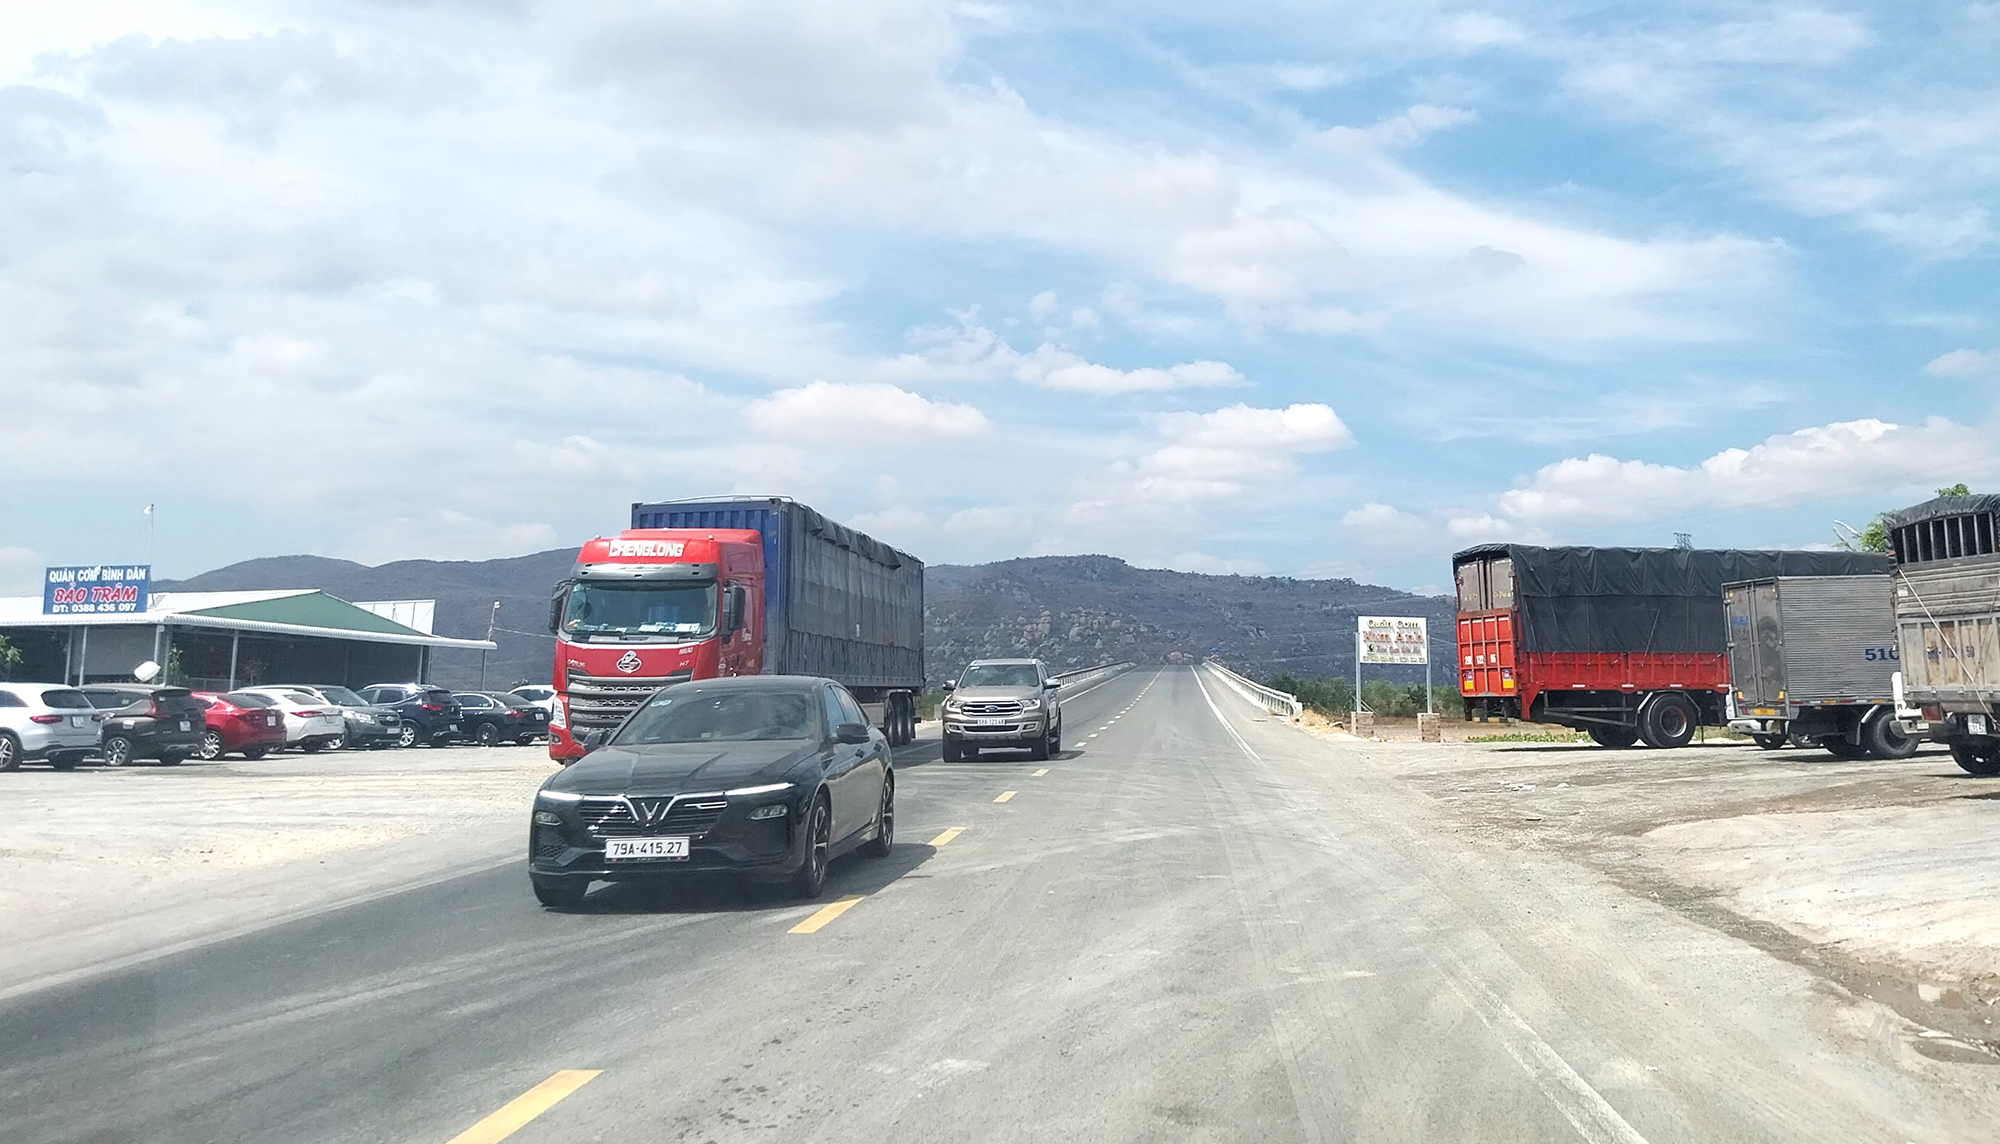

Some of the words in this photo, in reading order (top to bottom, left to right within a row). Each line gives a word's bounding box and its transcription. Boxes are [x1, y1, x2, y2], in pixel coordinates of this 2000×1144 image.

[609, 541, 684, 557] CHENGLONG
[49, 568, 75, 582] QUÁN
[101, 567, 124, 581] BÌNH
[126, 566, 146, 580] DÂN
[53, 582, 88, 604] BẢO
[91, 583, 138, 603] TRÂM
[118, 603, 137, 611] 097
[612, 841, 683, 855] 79A-415.27
